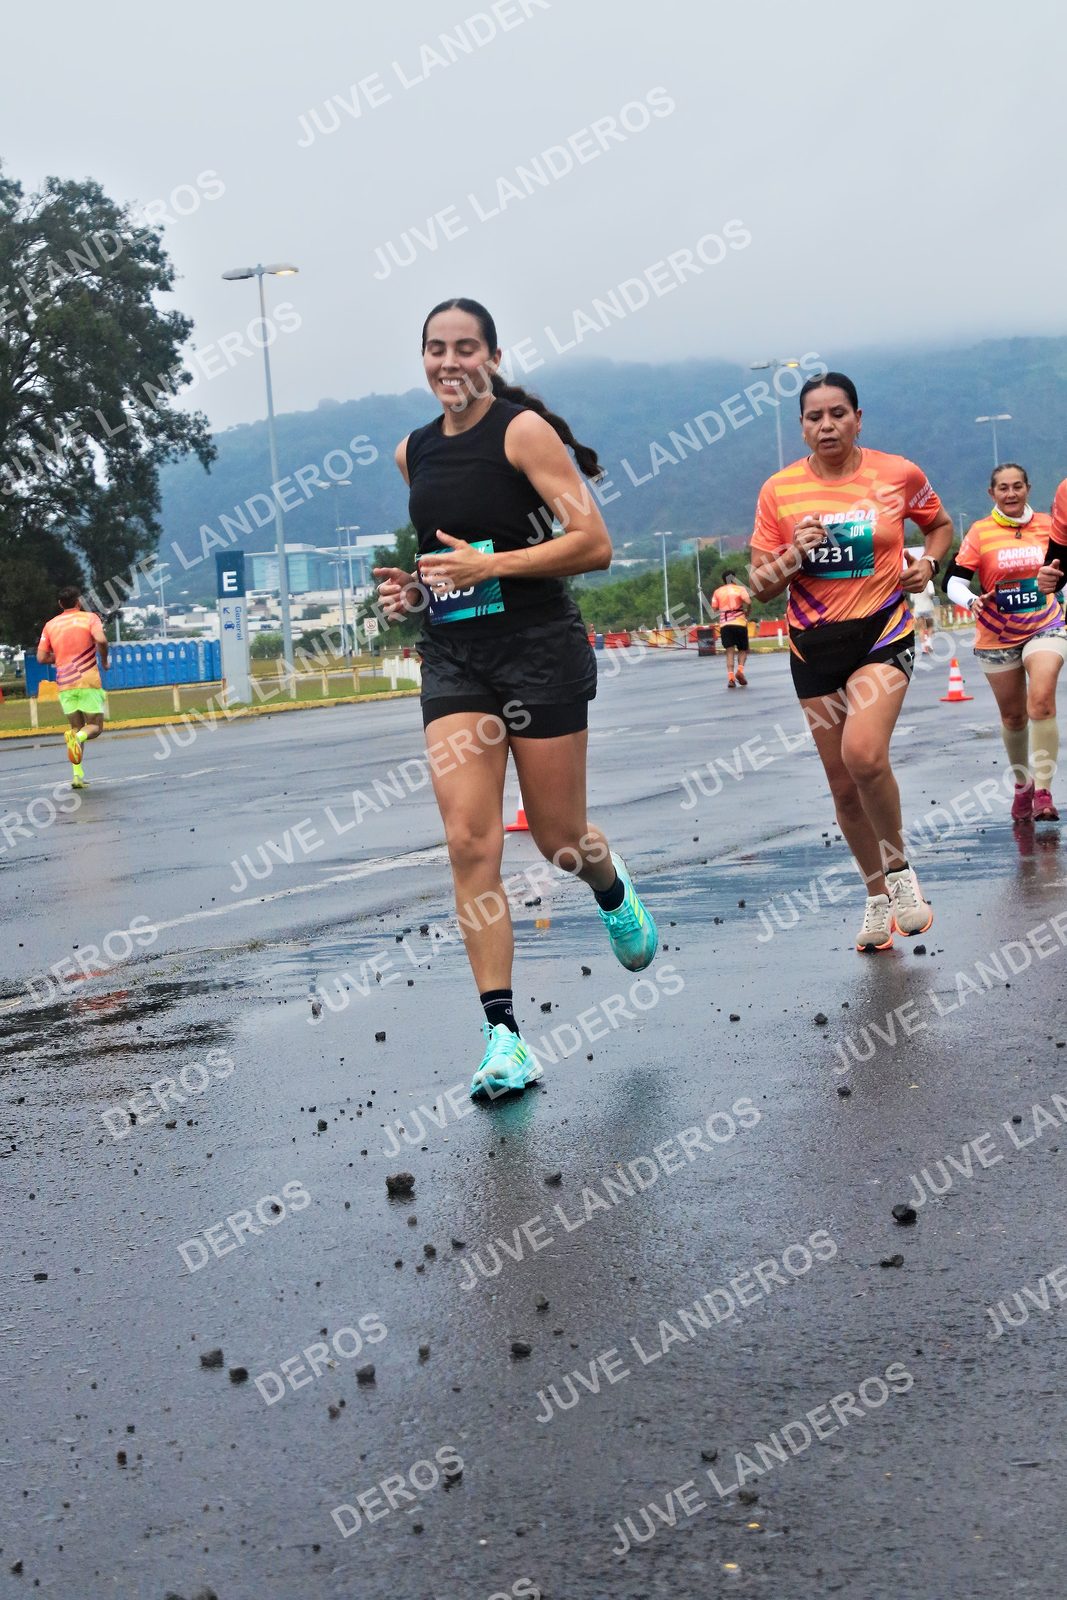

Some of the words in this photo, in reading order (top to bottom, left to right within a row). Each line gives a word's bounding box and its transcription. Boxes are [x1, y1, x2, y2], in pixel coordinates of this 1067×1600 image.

[850, 526, 865, 537] 10K
[807, 546, 854, 563] 1231
[223, 571, 238, 592] E
[1007, 592, 1038, 605] 1155
